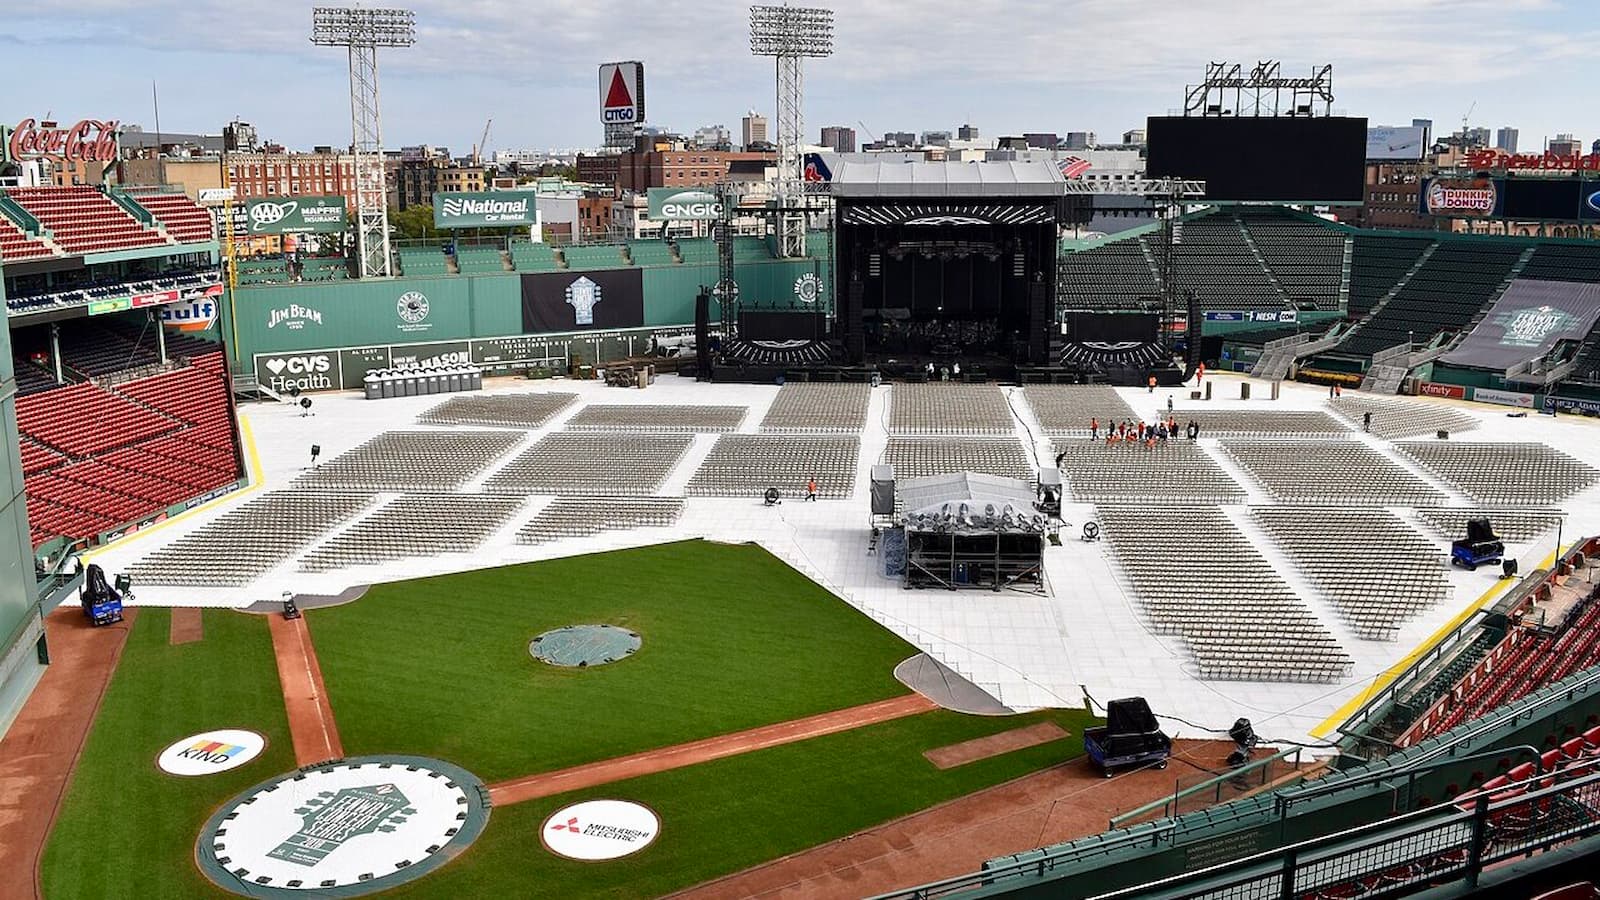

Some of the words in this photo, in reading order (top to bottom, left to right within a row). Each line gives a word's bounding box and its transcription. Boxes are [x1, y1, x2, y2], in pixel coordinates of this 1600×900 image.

[1183, 61, 1241, 110] John
[1246, 60, 1334, 102] Hancock
[605, 108, 633, 121] CITGO
[9, 118, 119, 161] Coca-Cola
[301, 207, 342, 215] MAPFRE
[1446, 199, 1489, 208] DONUTS
[255, 204, 281, 222] AAA
[304, 215, 341, 223] INSURANCE
[268, 308, 289, 328] JIM
[290, 304, 322, 325] BEAM
[287, 355, 330, 374] CVS
[420, 351, 468, 368] MASON
[269, 373, 332, 391] Health
[1421, 383, 1452, 397] xfinity
[177, 747, 230, 764] KIND
[330, 795, 395, 818] FENWAY
[314, 806, 380, 830] CONCERT
[303, 820, 357, 841] SERIES
[583, 827, 637, 842] ELECTRIC
[587, 824, 649, 838] MITSUBISHI
